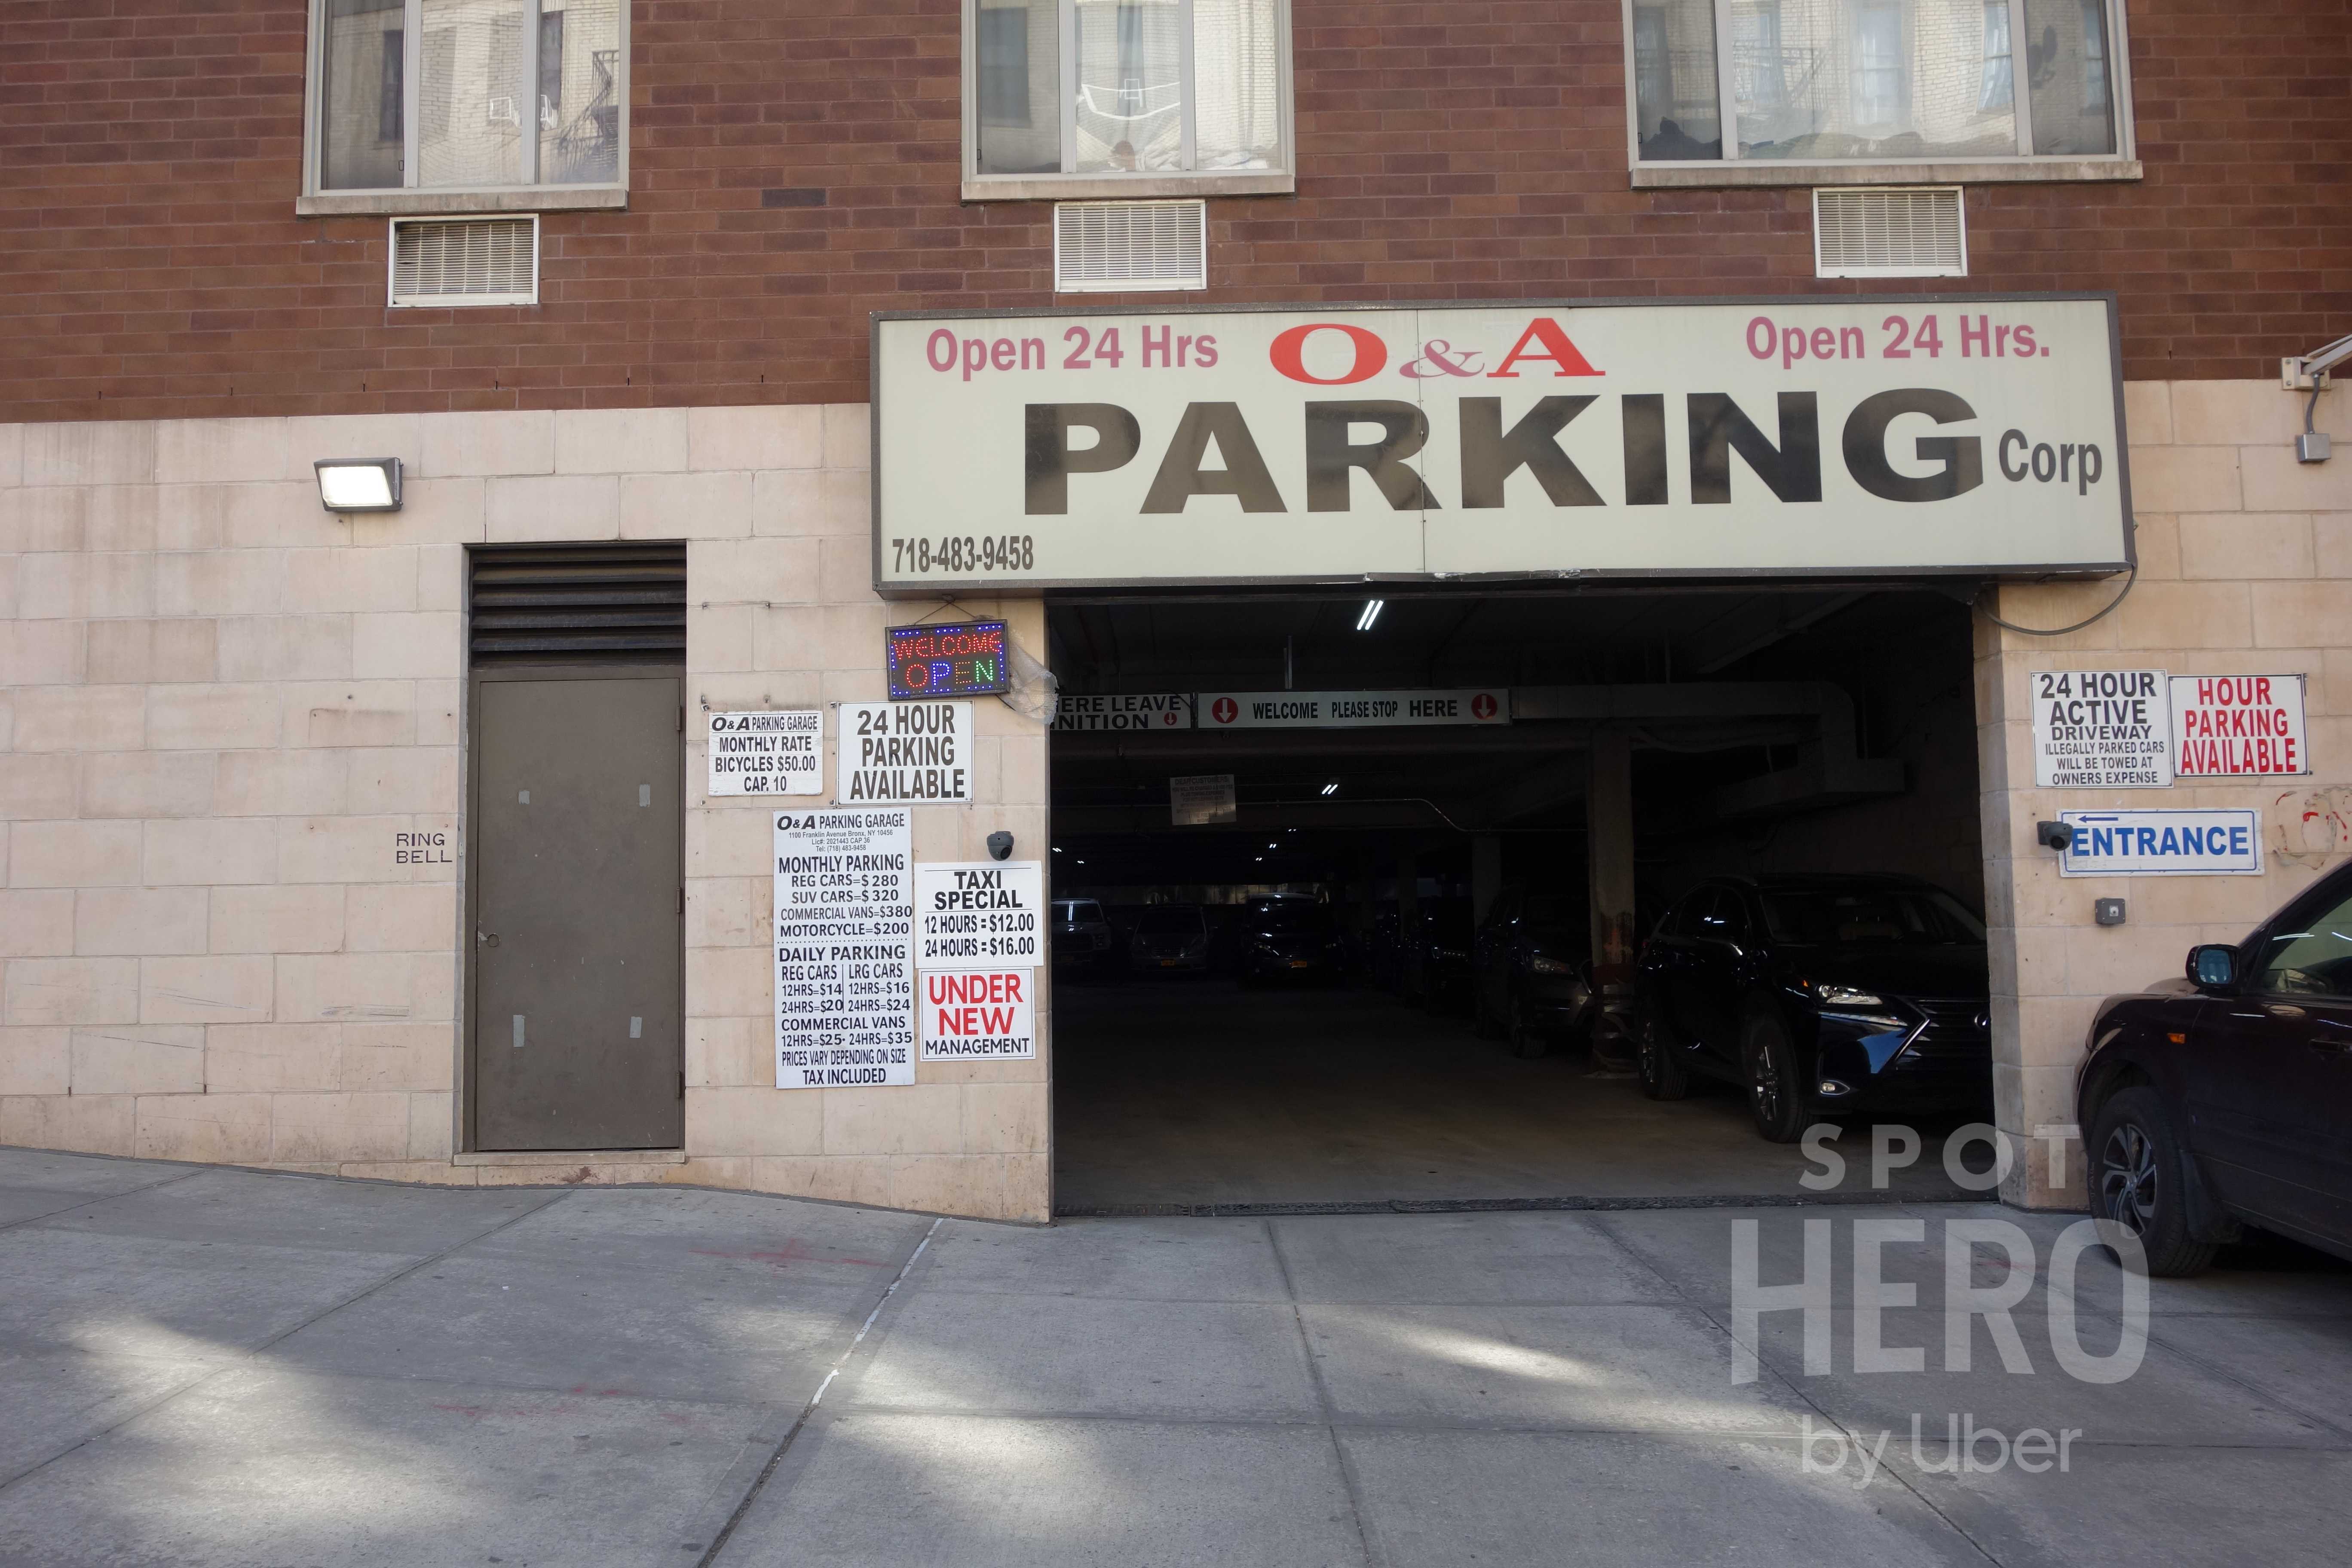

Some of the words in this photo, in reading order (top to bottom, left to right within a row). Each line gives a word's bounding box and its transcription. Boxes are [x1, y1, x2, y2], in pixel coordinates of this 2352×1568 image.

[1746, 316, 1865, 369] Open
[1881, 314, 1943, 358] 24
[1961, 314, 2050, 357] Hrs.
[927, 328, 1045, 381] Open
[1063, 326, 1124, 369] 24
[1142, 325, 1219, 368] Hrs
[1025, 388, 1984, 515] PARKING
[1999, 429, 2103, 495] Corp
[892, 536, 1034, 573] 718-483-9458
[894, 631, 1001, 659] WELCOME
[906, 660, 993, 687] OPEN
[2040, 674, 2071, 698] 24
[2081, 672, 2157, 698] HOUR
[2198, 677, 2272, 706] HOUR
[1056, 697, 1104, 712] ERE
[1112, 696, 1181, 711] LEAVE
[1253, 702, 1318, 719] WELCOME
[1332, 701, 1369, 718] PLEASE
[1373, 701, 1398, 717] STOP
[1410, 700, 1458, 717] HERE
[2050, 700, 2148, 726] ACTIVE
[752, 717, 784, 731] PARKING
[787, 716, 817, 730] GARAGE
[858, 710, 888, 735] 24
[896, 705, 955, 735] HOUR
[1052, 714, 1148, 729] NITION
[2185, 709, 2288, 738] PARKING
[2052, 725, 2152, 741] DRIVEWAY
[720, 736, 778, 752] MONTHLY
[782, 736, 812, 752] RATE
[862, 736, 954, 767] PARKING
[2046, 742, 2095, 755] ILLEGALLY
[2099, 741, 2137, 754] PARKED
[2140, 741, 2164, 753] CARS
[715, 756, 773, 772] BICYCLES
[777, 755, 815, 773] $50.00
[2057, 758, 2082, 769] WILL
[2085, 757, 2098, 769] BE
[2101, 756, 2138, 769] TOWED
[2141, 756, 2153, 768] AT
[2181, 738, 2297, 774] AVAILABLE
[744, 776, 769, 792] CAP.
[774, 776, 787, 791] 10
[850, 769, 965, 799] AVAILABLE
[2052, 772, 2102, 785] OWNERS
[2106, 772, 2158, 784] EXPENSE
[820, 815, 862, 829] PARKING
[865, 813, 905, 827] GARAGE
[397, 833, 444, 846] RING
[2072, 827, 2249, 856] ENTRANCE
[396, 850, 452, 863] BELL
[779, 855, 842, 873] MONTHLY
[846, 854, 904, 872] PARKING
[792, 875, 815, 887] REG
[954, 870, 1001, 890] TAXI
[791, 891, 817, 904] SUV
[934, 890, 1023, 910] SPECIAL
[781, 907, 845, 921] COMMERCIAL
[925, 916, 936, 934] 12
[940, 915, 977, 934] HOURS
[989, 913, 1034, 934] $12.00
[779, 947, 826, 962] DAILY
[831, 945, 905, 961] PARKING
[925, 939, 937, 957] 24
[940, 938, 977, 957] HOURS
[990, 937, 1034, 958] $16.00
[782, 965, 803, 981] REG
[808, 965, 837, 980] CARS
[848, 964, 870, 979] LRG
[873, 963, 903, 978] CARS
[929, 974, 1024, 1005] UNDER
[781, 1017, 868, 1031] COMMERCIAL
[872, 1016, 906, 1029] VANS
[939, 1007, 1015, 1036] NEW
[925, 1038, 1029, 1055] MANAGEMENT
[782, 1051, 807, 1066] PRICES
[810, 1050, 828, 1066] VARY
[831, 1049, 874, 1065] DEPENDING
[876, 1049, 888, 1064] ON
[891, 1048, 906, 1063] SIZE
[803, 1070, 824, 1085] TAX
[828, 1068, 886, 1084] INCLUDED
